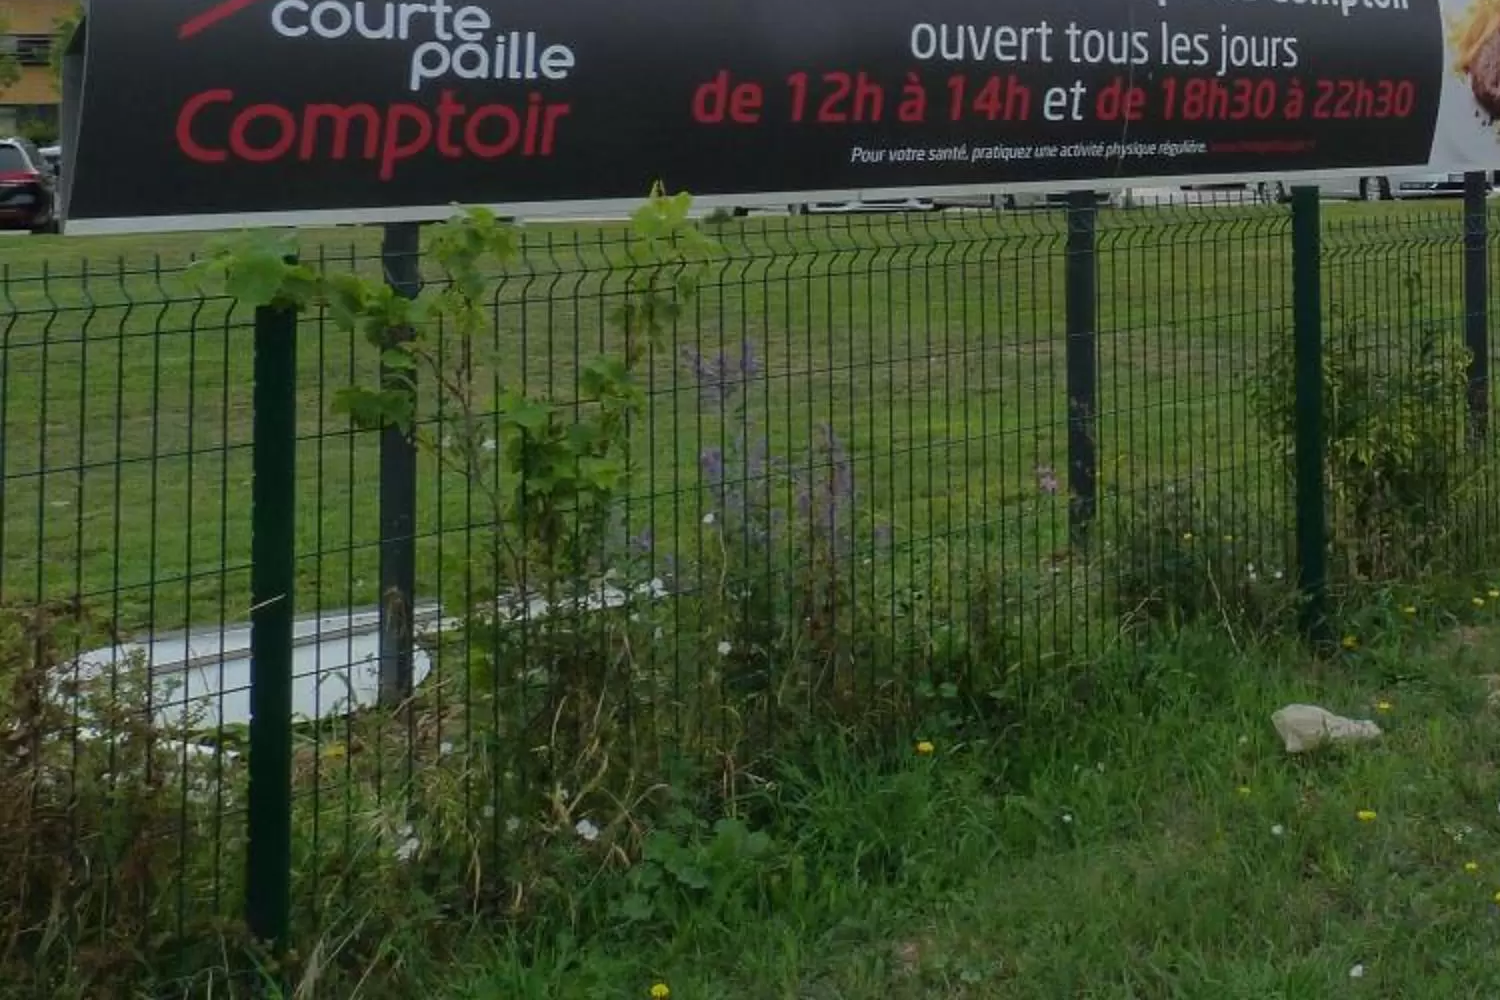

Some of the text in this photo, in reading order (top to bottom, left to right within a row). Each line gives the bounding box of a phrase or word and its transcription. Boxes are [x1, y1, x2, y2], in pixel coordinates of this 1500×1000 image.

[410, 32, 575, 91] paille
[911, 21, 1299, 77] ouvert tous les jours
[692, 70, 1415, 123] de 12h à 14h et de 18h30 à 22h30
[176, 89, 570, 180] Comptoir
[851, 147, 886, 162] Pour
[889, 147, 925, 161] votre
[971, 144, 1032, 162] pratiquez
[1035, 145, 1058, 157] une
[1059, 141, 1104, 157] activité
[1105, 141, 1156, 159] physique
